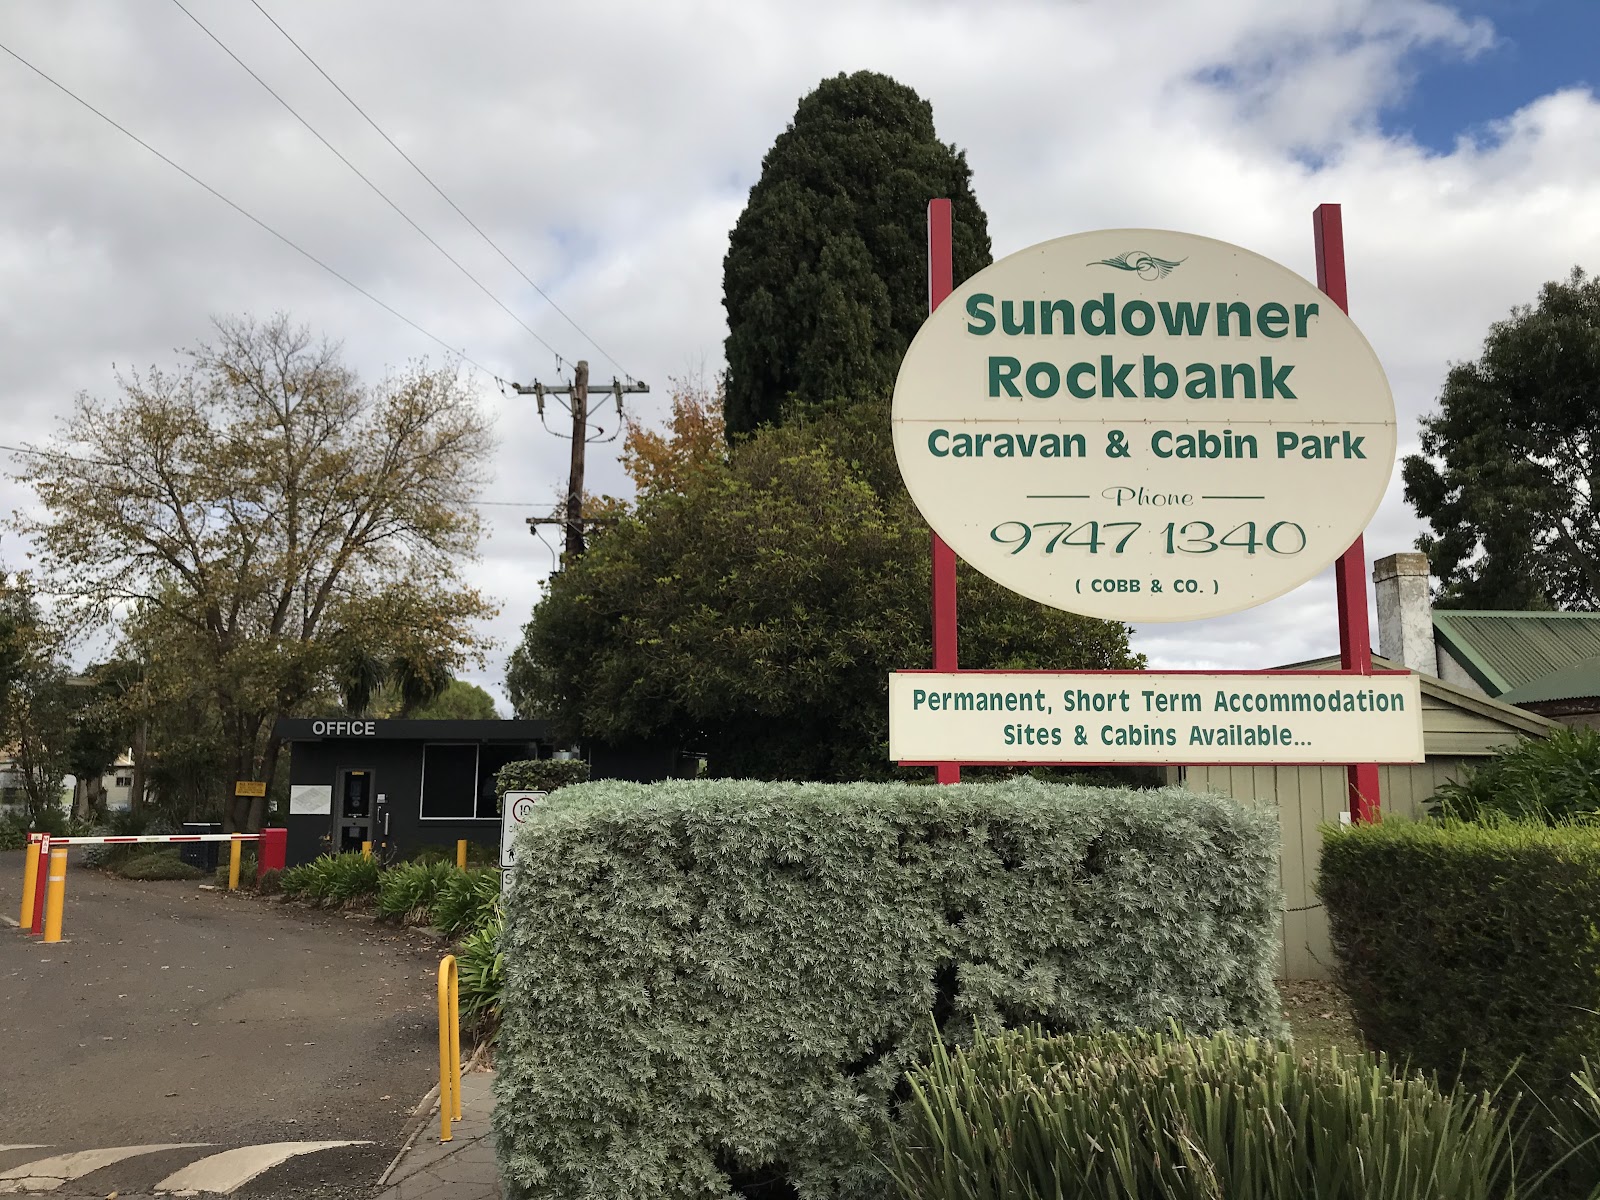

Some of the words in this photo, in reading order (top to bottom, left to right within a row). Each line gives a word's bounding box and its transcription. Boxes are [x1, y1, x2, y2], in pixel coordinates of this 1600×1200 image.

[964, 292, 1320, 340] Sundowner
[987, 354, 1298, 400] Rockbank
[927, 428, 1087, 459] Caravan
[1105, 429, 1132, 460] &
[1151, 429, 1259, 460] Cabin
[1276, 430, 1367, 460] Park
[1101, 486, 1195, 508] Phone
[989, 520, 1142, 556] 9747
[1161, 520, 1308, 556] 1340
[1091, 578, 1141, 594] COBB
[1150, 579, 1163, 594] &
[1173, 579, 1205, 594] CO.
[912, 688, 1053, 715] Permanent,
[1063, 689, 1130, 713] Short
[1141, 690, 1202, 713] Term
[1214, 689, 1406, 714] Accommodation
[312, 720, 376, 736] OFFICE
[1003, 723, 1062, 746] Sites
[1073, 724, 1089, 746] &
[1100, 724, 1178, 747] Cabins
[1189, 724, 1312, 747] Available...
